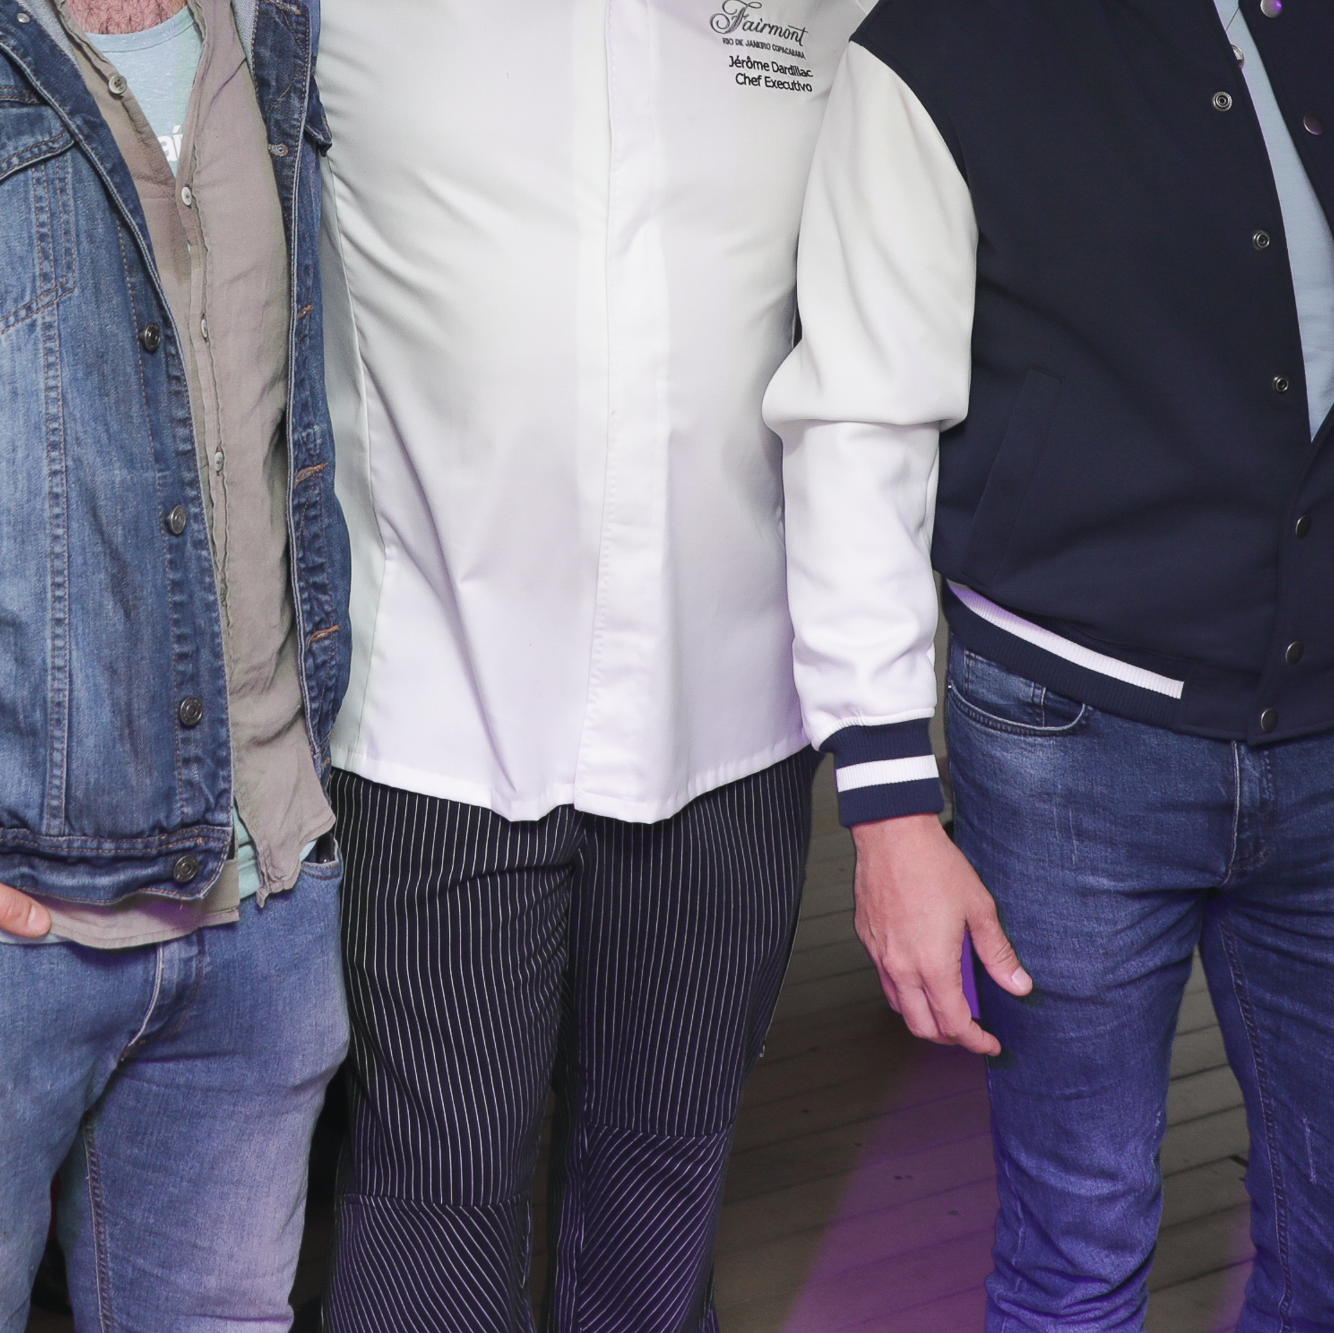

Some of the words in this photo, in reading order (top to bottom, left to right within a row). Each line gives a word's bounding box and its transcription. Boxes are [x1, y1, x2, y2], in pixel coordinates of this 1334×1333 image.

[734, 38, 744, 47] DE
[728, 55, 770, 72] Jérôme
[771, 61, 814, 78] Dardillac
[735, 72, 763, 87] Chef
[764, 76, 813, 93] Executivo
